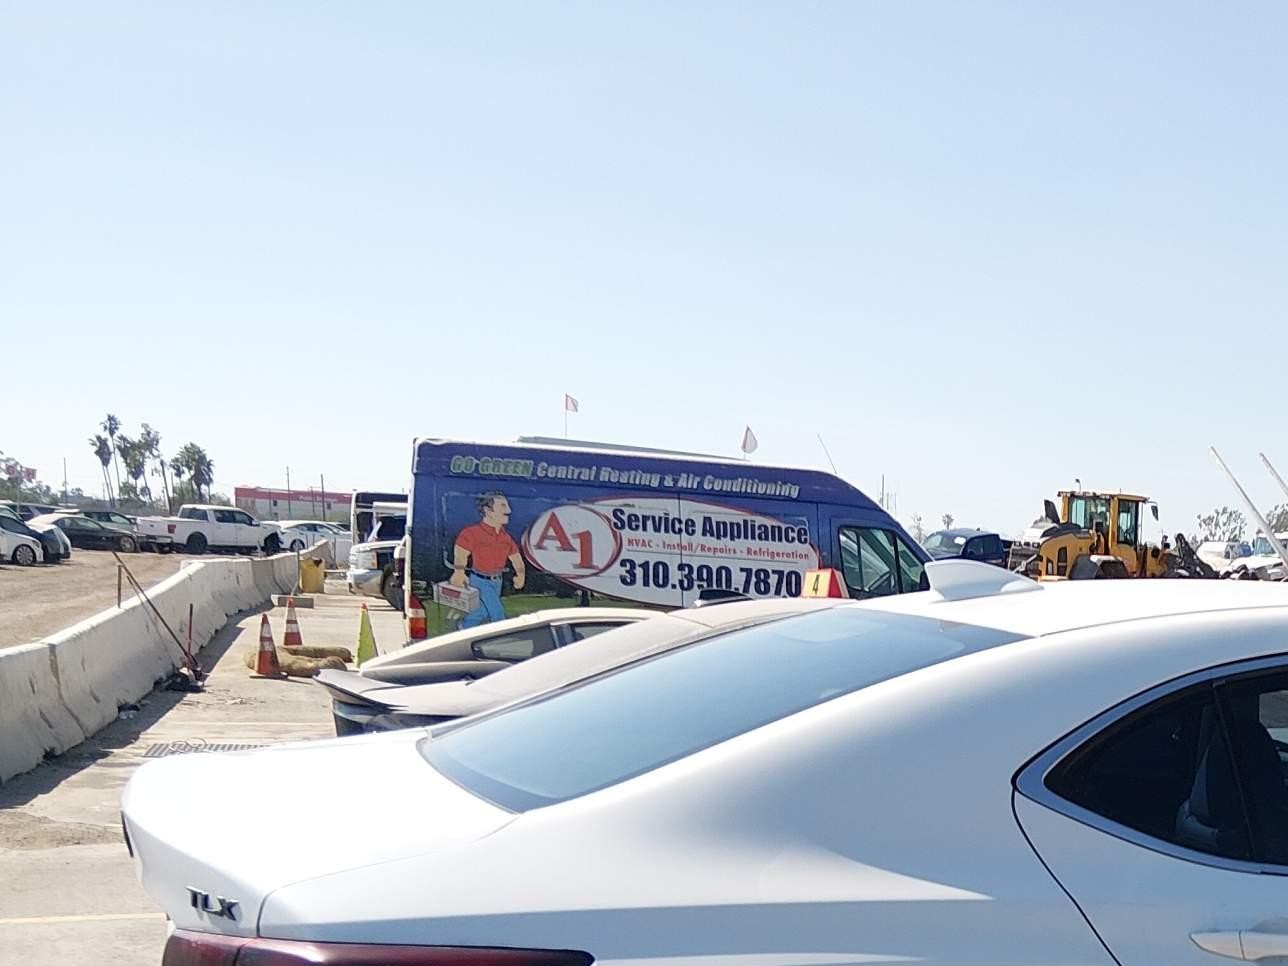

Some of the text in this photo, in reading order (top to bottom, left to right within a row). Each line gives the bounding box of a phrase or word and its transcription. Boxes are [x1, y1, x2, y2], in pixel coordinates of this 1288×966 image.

[479, 457, 534, 477] GREEN
[537, 462, 595, 481] Central
[599, 467, 660, 487] Heating
[664, 474, 675, 487] &
[678, 473, 701, 489] Air
[703, 474, 800, 499] Conditioning
[612, 508, 809, 545] Service Appliance
[627, 537, 653, 549] HVAC
[662, 541, 738, 556] Install/Repairs
[746, 547, 809, 560] Refrigeration
[619, 558, 802, 598] 310.390.7870
[812, 574, 820, 594] 4
[185, 886, 239, 921] TLX
